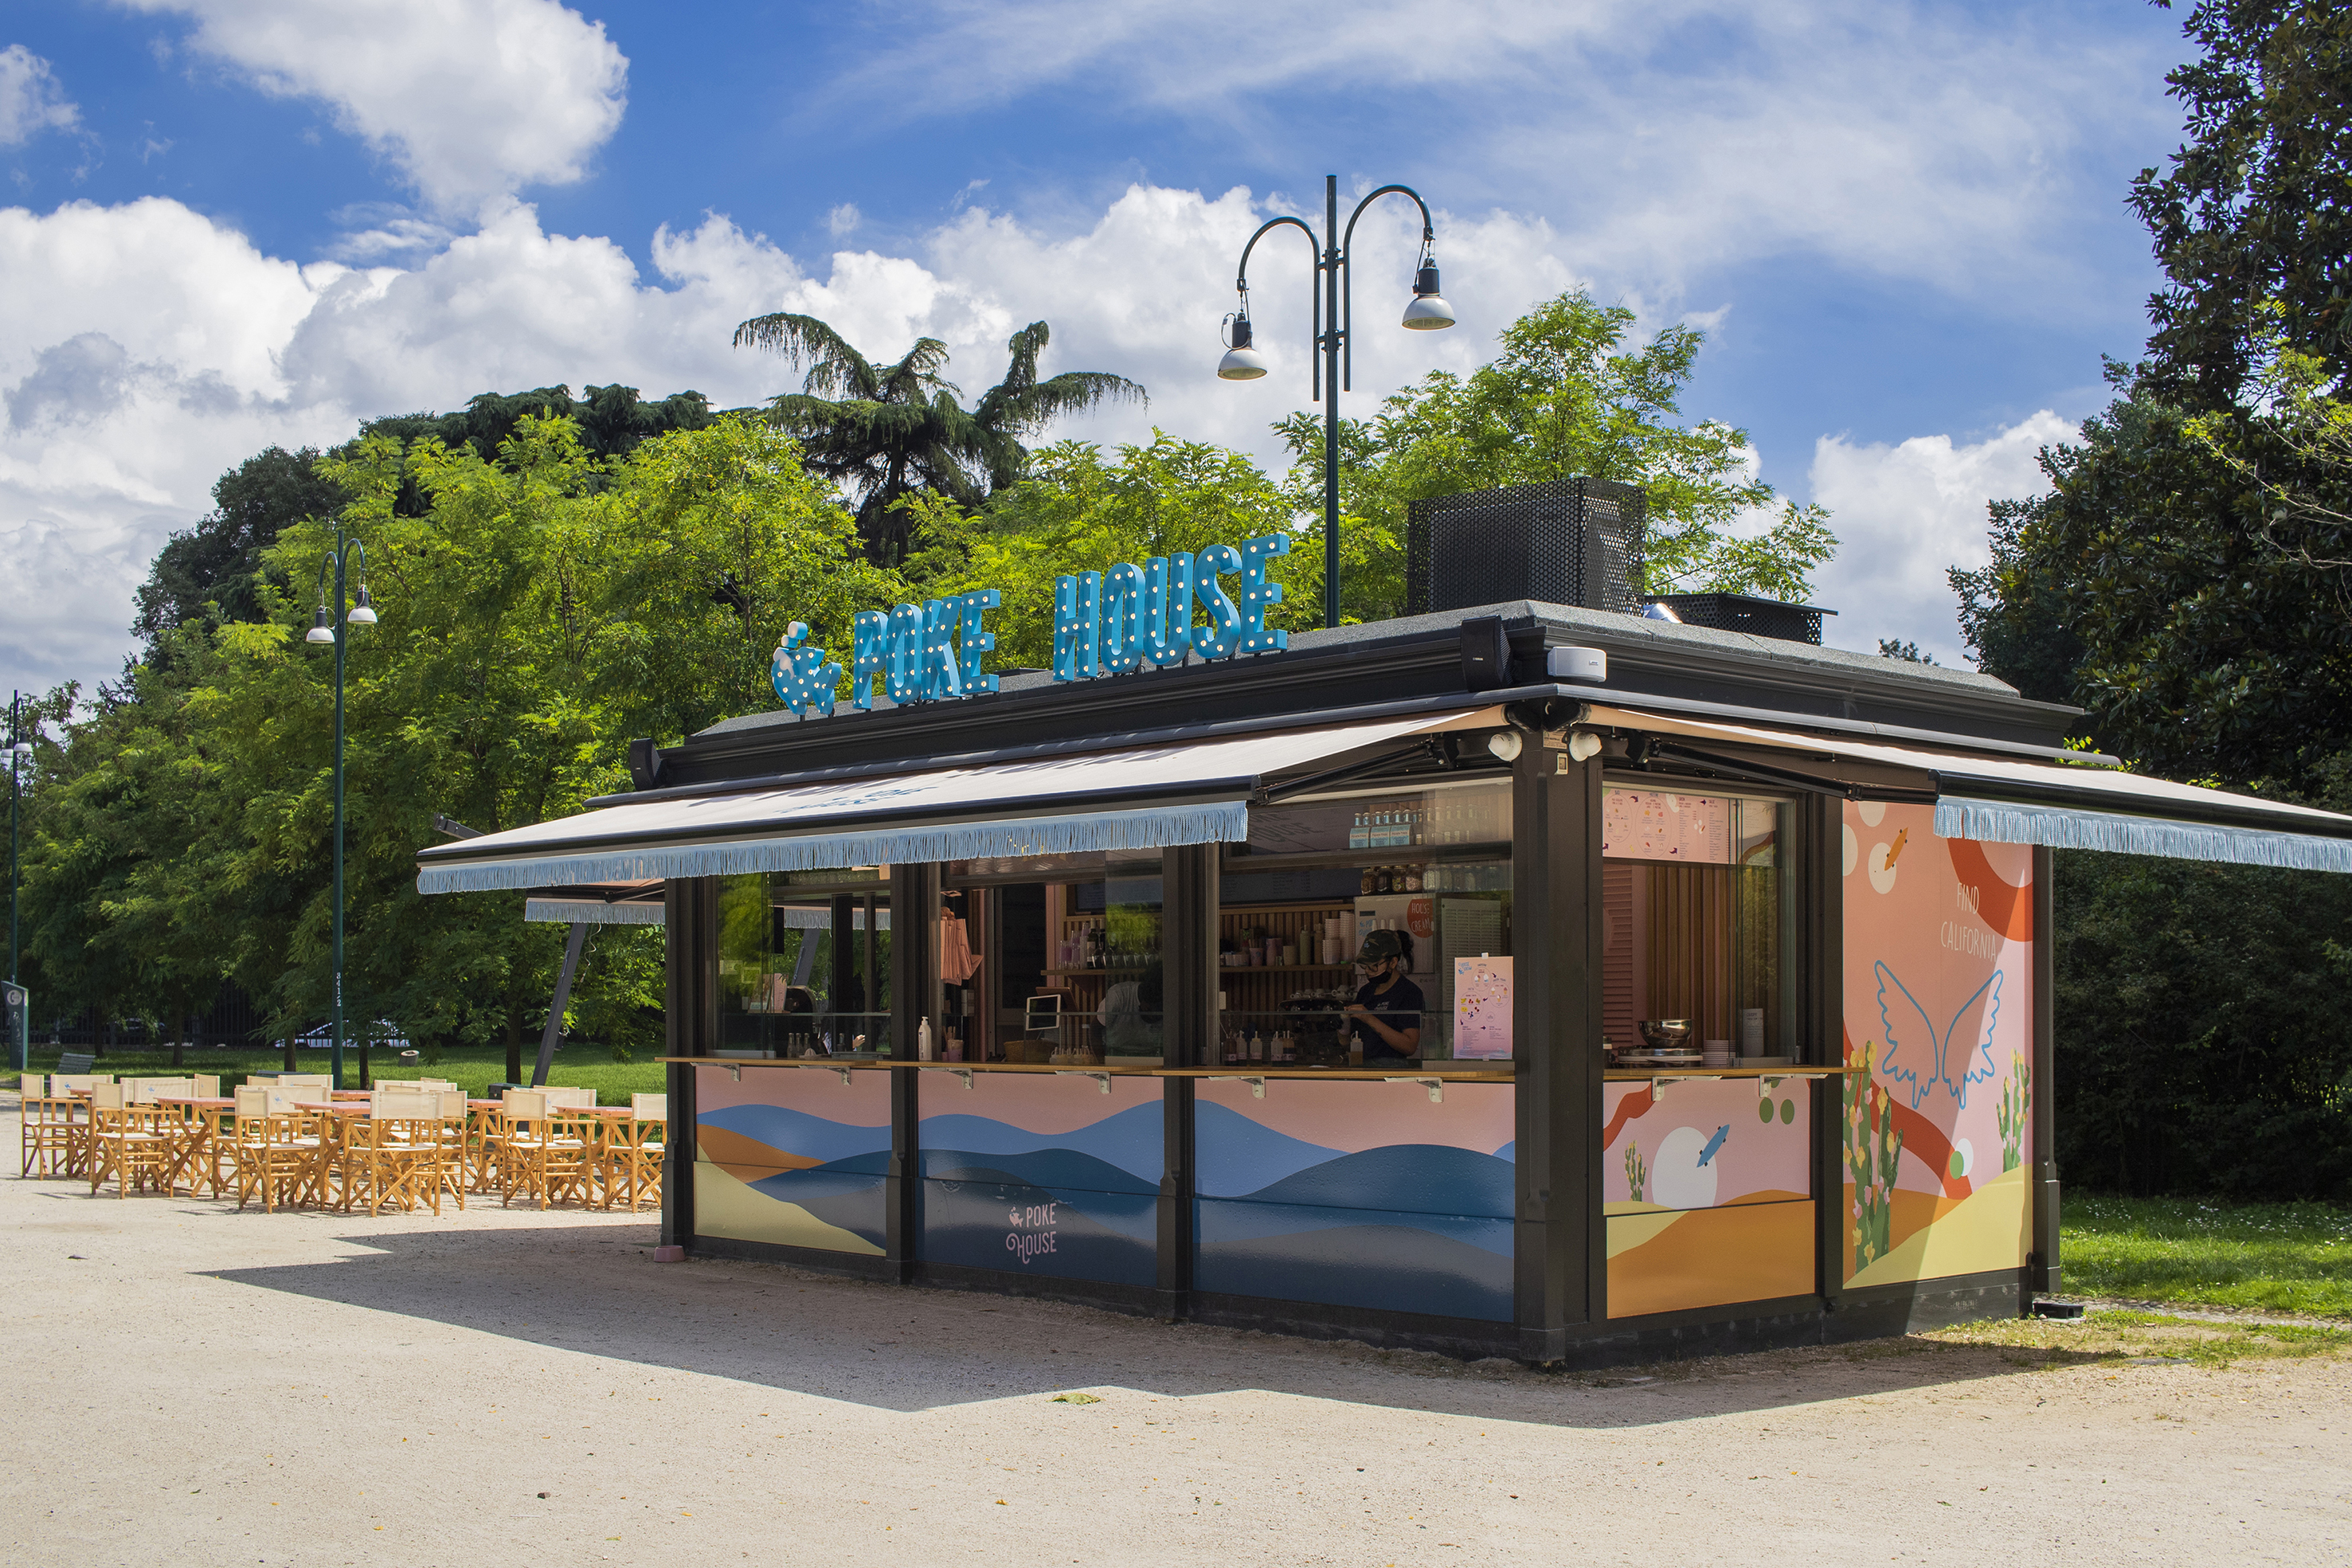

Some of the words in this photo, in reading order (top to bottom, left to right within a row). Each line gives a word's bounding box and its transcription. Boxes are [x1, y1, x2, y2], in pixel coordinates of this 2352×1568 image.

[852, 589, 1000, 710] POKE
[1053, 534, 1289, 682] HOUSE
[1411, 902, 1430, 914] HOUSE
[1957, 882, 1980, 914] FIND
[1411, 917, 1431, 933] CREAM
[1940, 921, 1997, 963] CALIFORNIA
[1026, 1202, 1057, 1227] POKE
[1005, 1230, 1057, 1265] HOUSE
